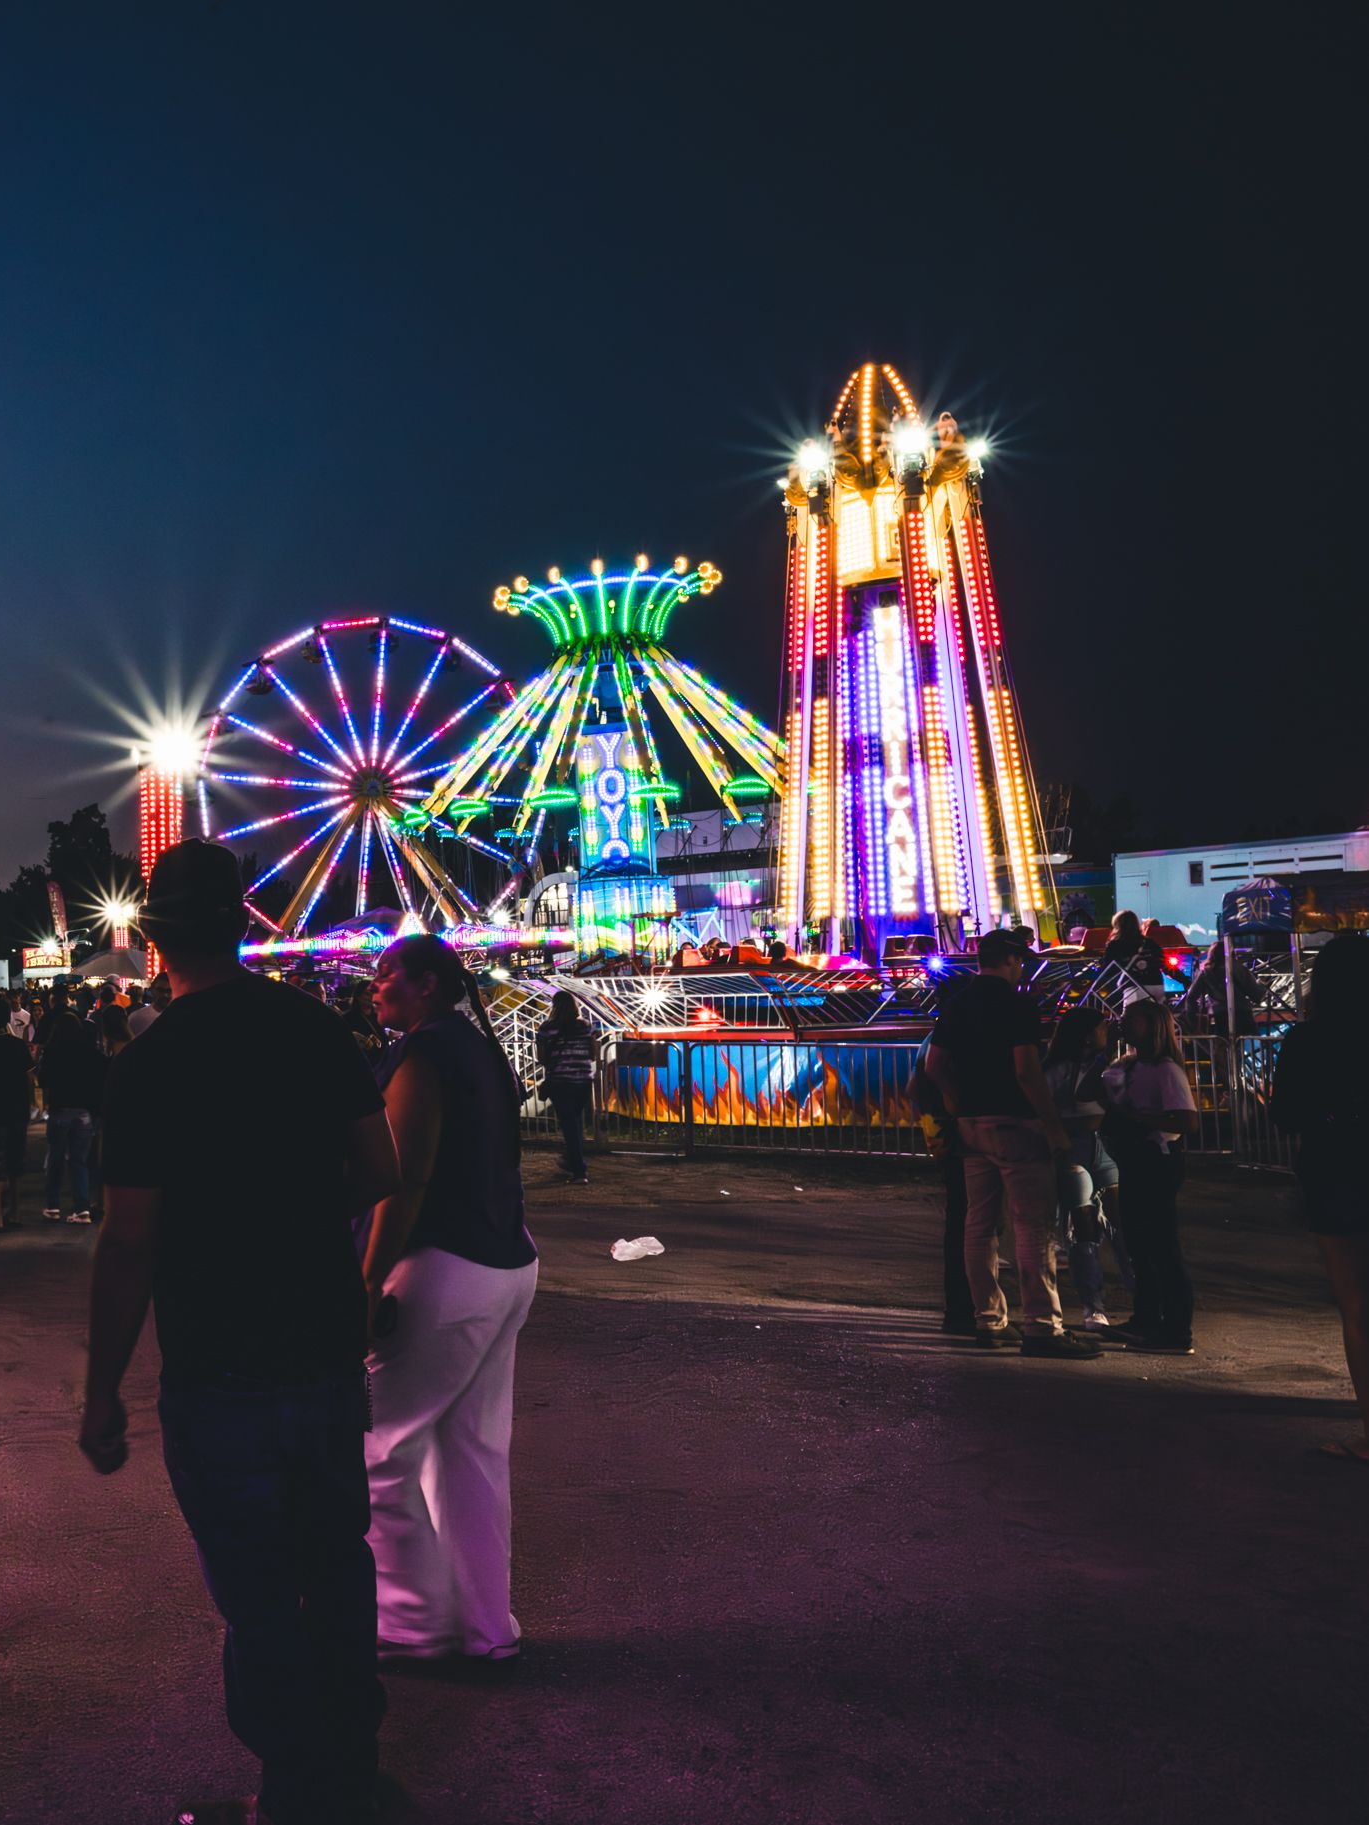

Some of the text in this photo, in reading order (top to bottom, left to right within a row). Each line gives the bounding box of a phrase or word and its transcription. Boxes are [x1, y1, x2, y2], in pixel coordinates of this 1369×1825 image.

[873, 606, 917, 913] HURRICANE
[596, 733, 630, 859] YOYO
[1235, 896, 1272, 922] EXIT
[25, 947, 63, 959] HAS
[30, 956, 63, 967] BELTS
